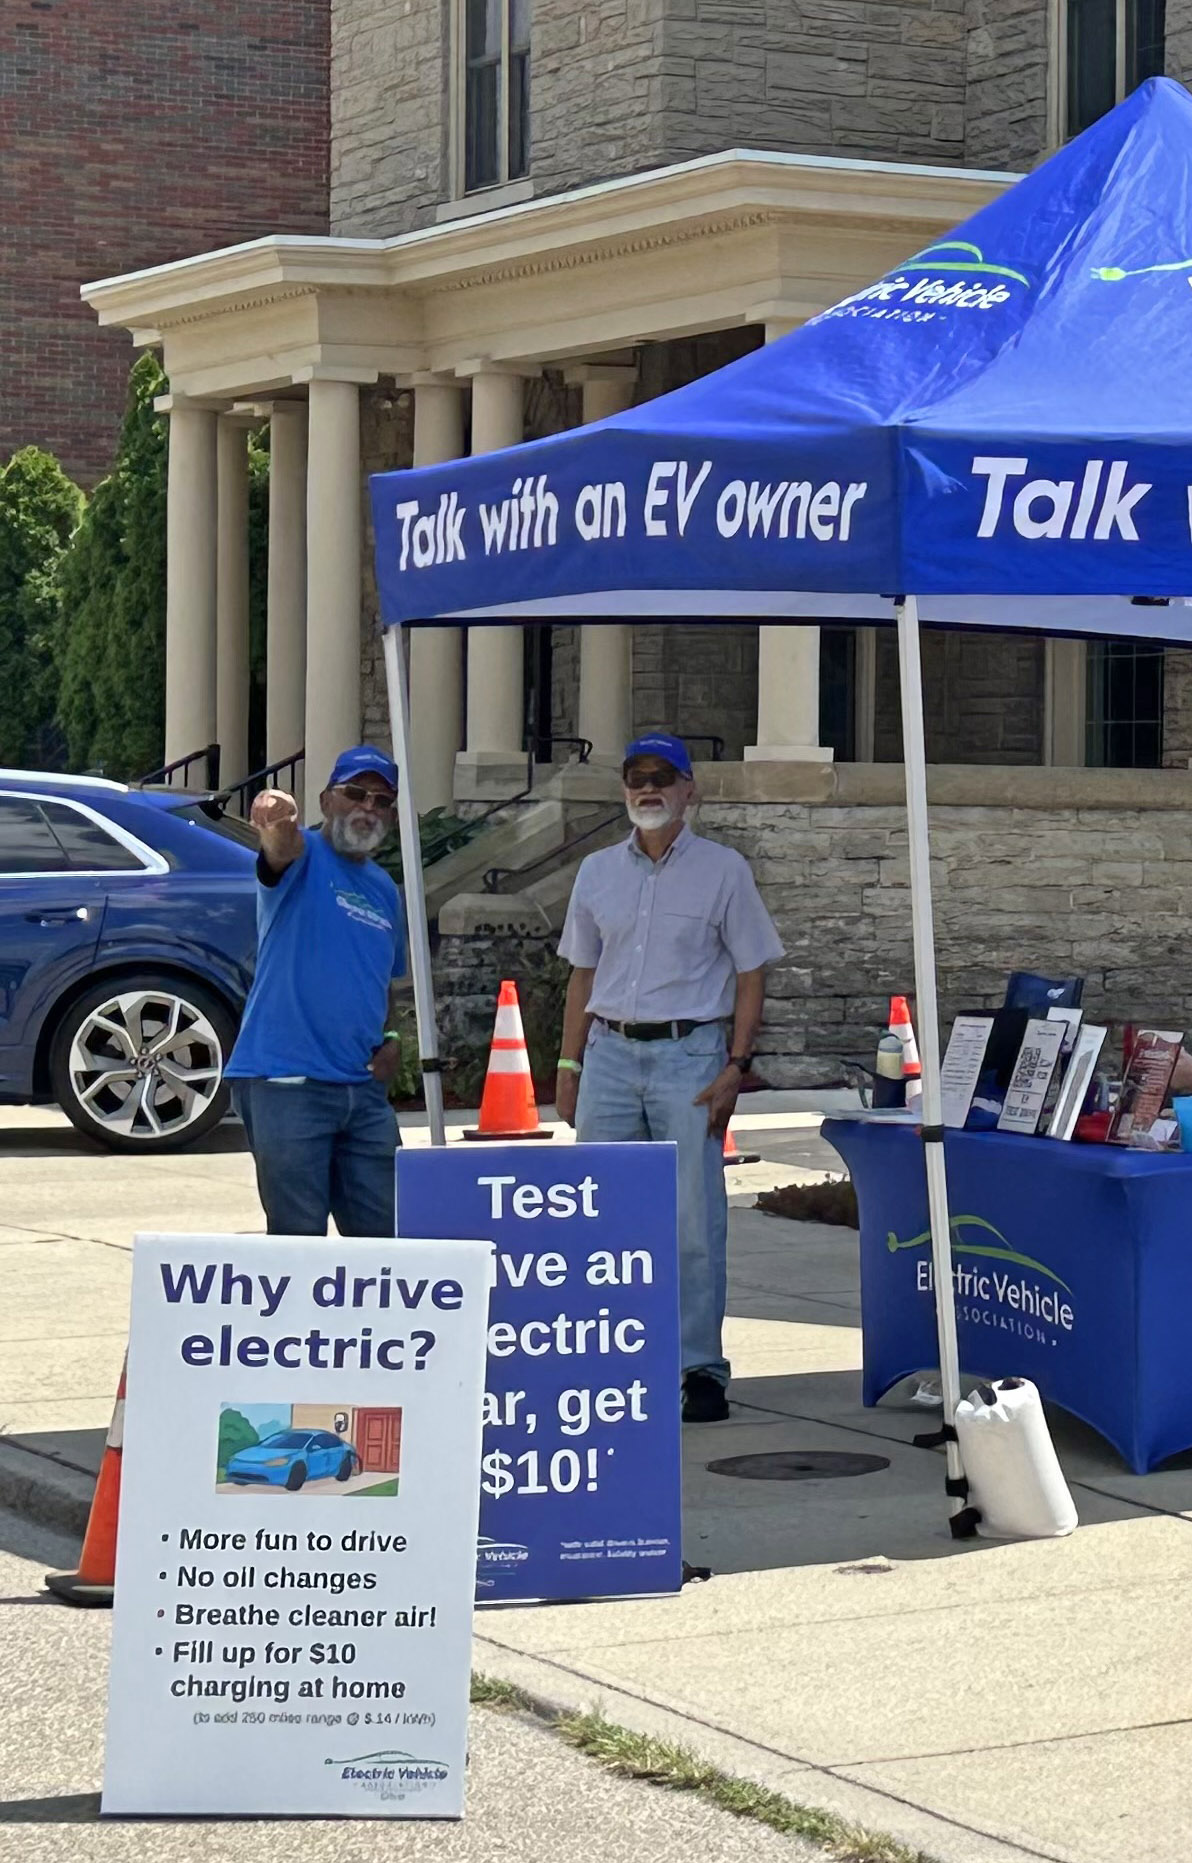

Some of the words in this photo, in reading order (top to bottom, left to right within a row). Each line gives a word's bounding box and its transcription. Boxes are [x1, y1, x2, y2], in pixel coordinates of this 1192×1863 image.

[396, 490, 467, 571] Talk
[481, 474, 558, 555] with
[575, 481, 627, 541] an
[644, 460, 712, 537] EV
[716, 475, 867, 542] owner
[972, 457, 1152, 541] Talk
[476, 1174, 600, 1220] Test
[160, 1262, 291, 1317] Why
[312, 1266, 464, 1312] drive
[489, 1249, 567, 1289] ive
[585, 1248, 654, 1287] an
[917, 1261, 990, 1300] Eltric
[993, 1271, 1074, 1330] Vehicle
[486, 1308, 646, 1358] ectric
[956, 1305, 1046, 1344] SOCIATION
[180, 1325, 438, 1371] electric?
[481, 1392, 537, 1434] ar,
[557, 1378, 649, 1436] get
[179, 1528, 247, 1551] More
[255, 1528, 297, 1551] fun
[306, 1531, 333, 1552] to
[341, 1530, 408, 1552] drive
[177, 1566, 215, 1588] No
[222, 1566, 255, 1588] oil
[263, 1566, 377, 1595] changes
[175, 1604, 280, 1626] Breathe
[288, 1604, 387, 1628] cleaner
[394, 1605, 437, 1628] air!
[173, 1640, 214, 1663] Fill
[222, 1645, 256, 1669] up
[264, 1641, 302, 1664] for
[309, 1642, 356, 1665] $10
[170, 1674, 290, 1703] charging
[298, 1677, 325, 1699] at
[332, 1675, 406, 1699] home
